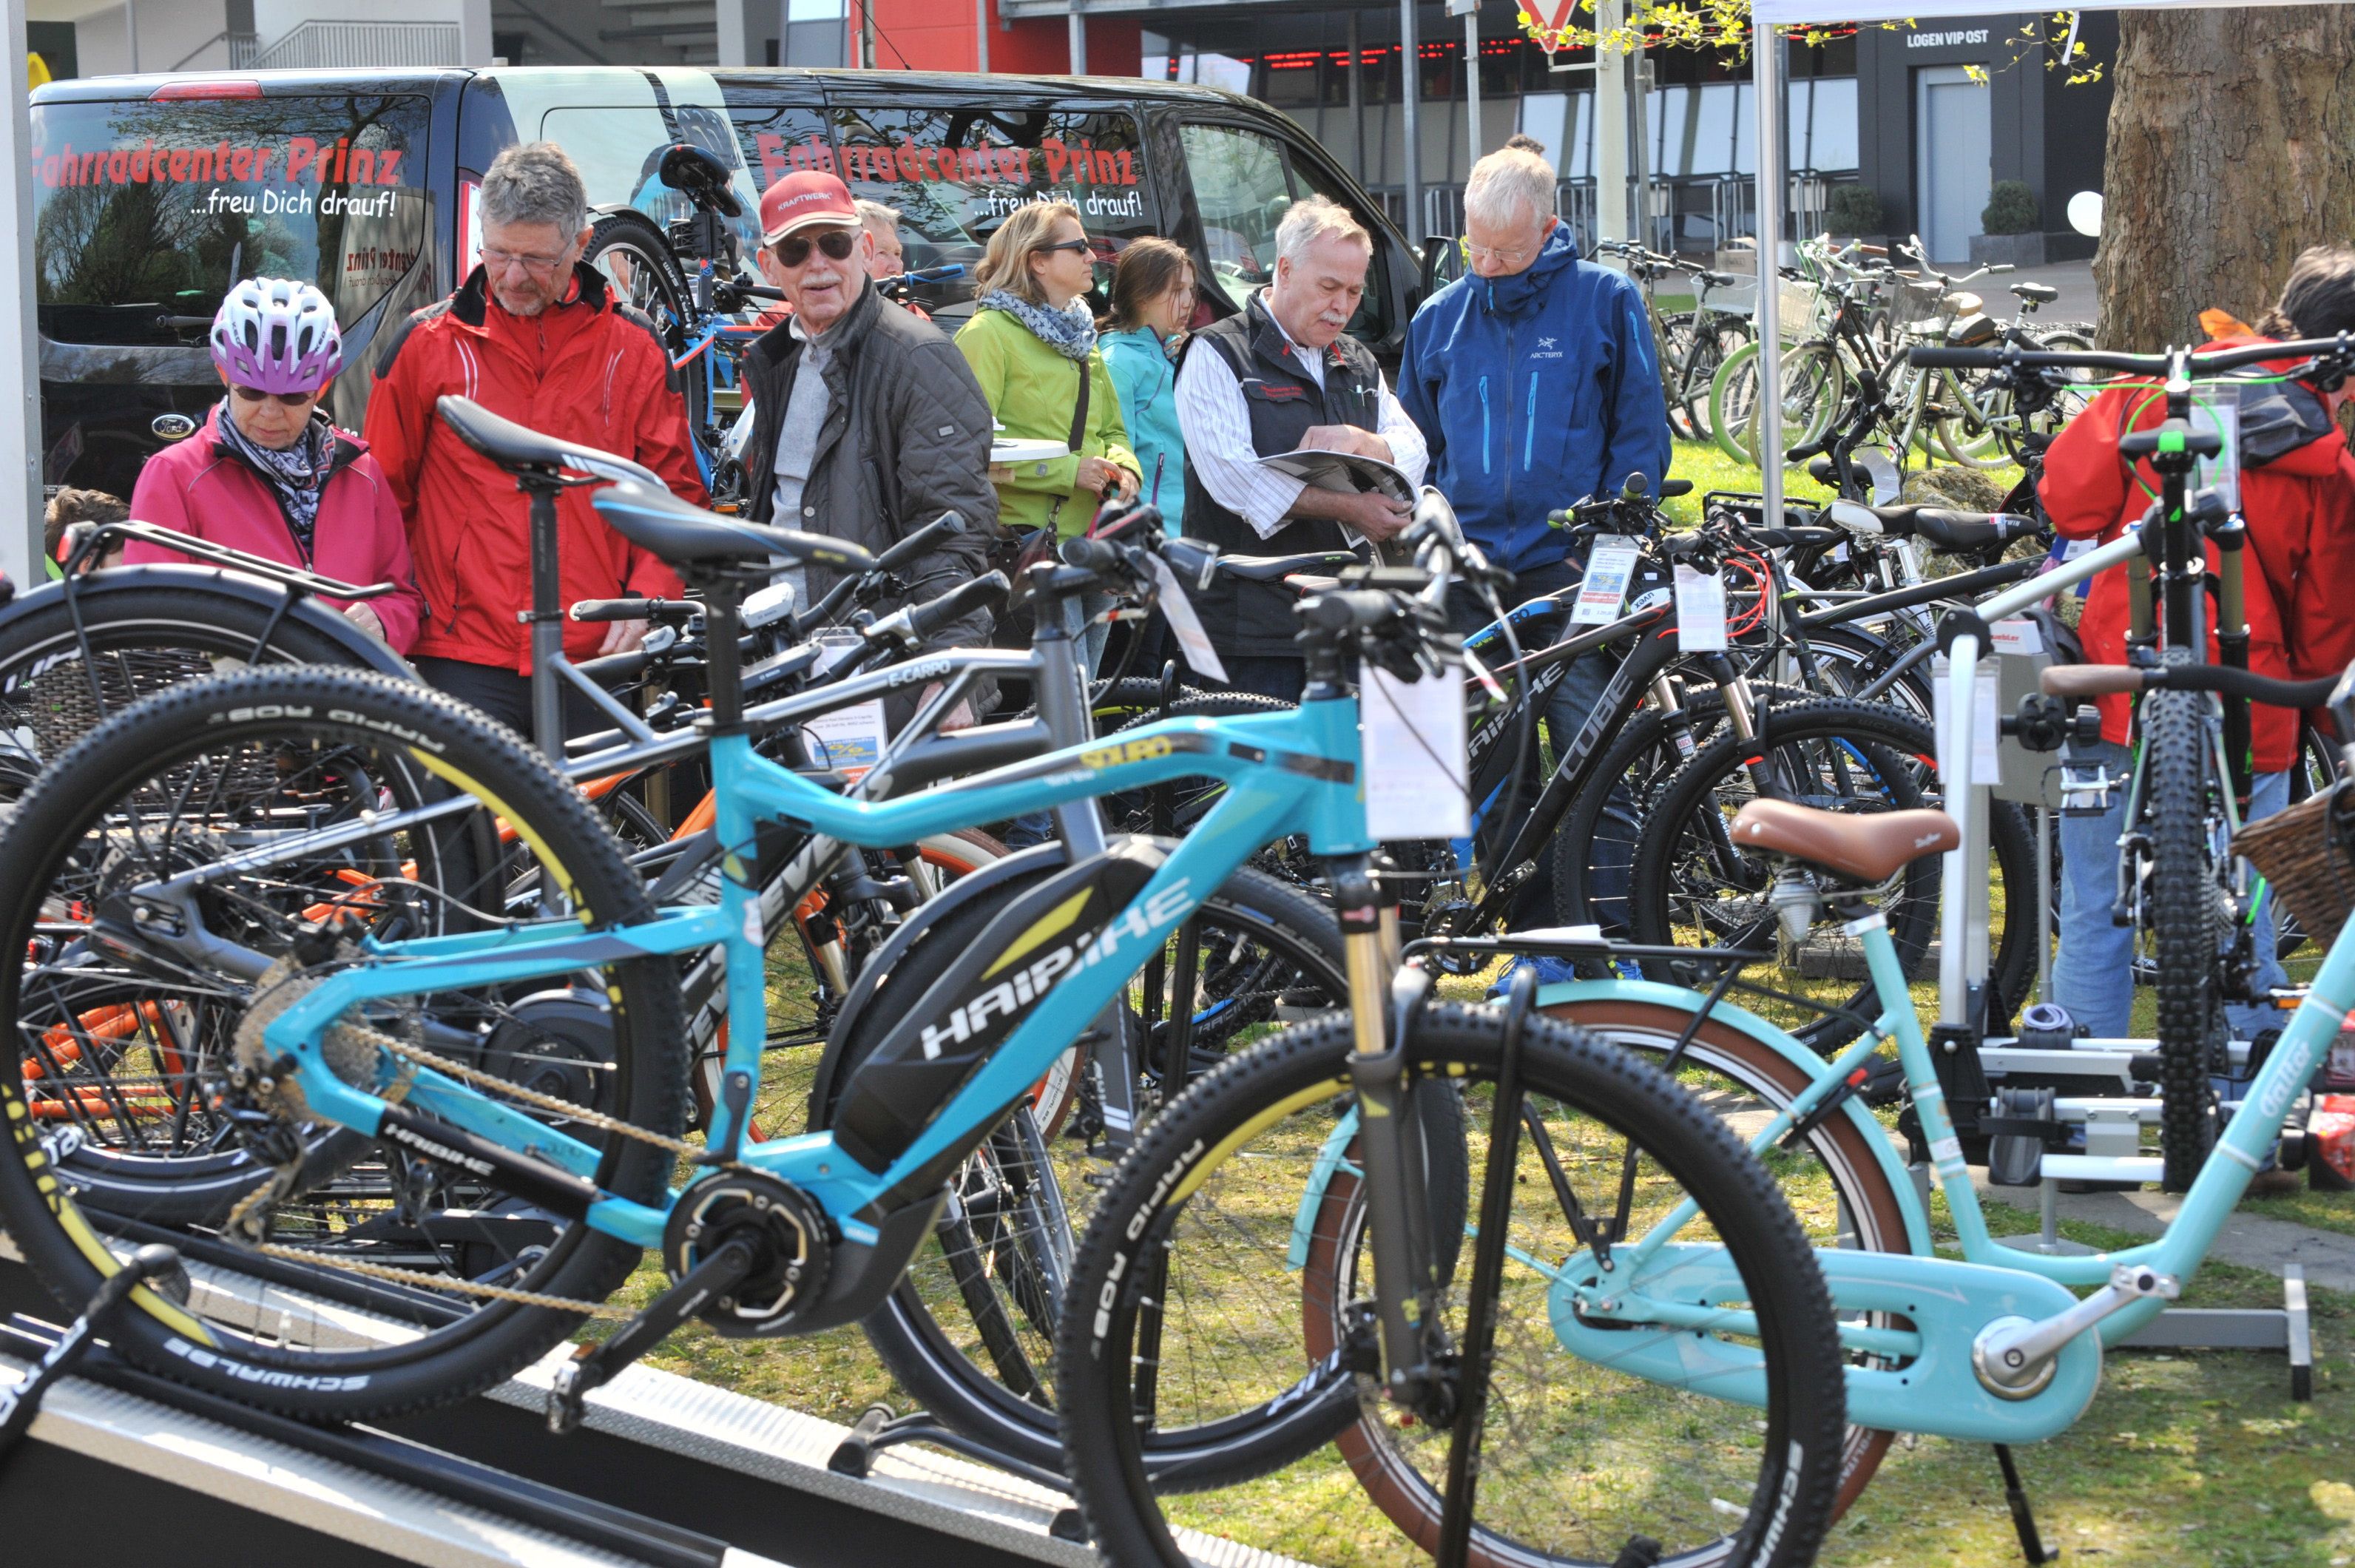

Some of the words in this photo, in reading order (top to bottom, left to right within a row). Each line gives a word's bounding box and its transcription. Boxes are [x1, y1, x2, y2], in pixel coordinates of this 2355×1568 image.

[1907, 33, 1944, 47] LOGEN
[1945, 31, 1965, 45] VIP
[1965, 29, 1990, 44] OST
[285, 137, 403, 184] Prinz
[756, 134, 1032, 186] Fahrradcenter
[1042, 138, 1138, 185] Prinz
[263, 189, 311, 214] Dich
[320, 189, 397, 218] drauf!
[777, 193, 831, 212] KRAFTWERK
[1086, 190, 1143, 218] drauf!
[314, 331, 326, 352] KED
[158, 417, 184, 433] Ford
[1635, 592, 1655, 609] uvex
[1560, 668, 1633, 782] CUBE
[921, 876, 1195, 1061] HAIBIKE
[383, 1122, 496, 1177] HAIBIKE
[163, 1337, 372, 1393] SCHWALBE
[1751, 1439, 1804, 1568] SCHWA
